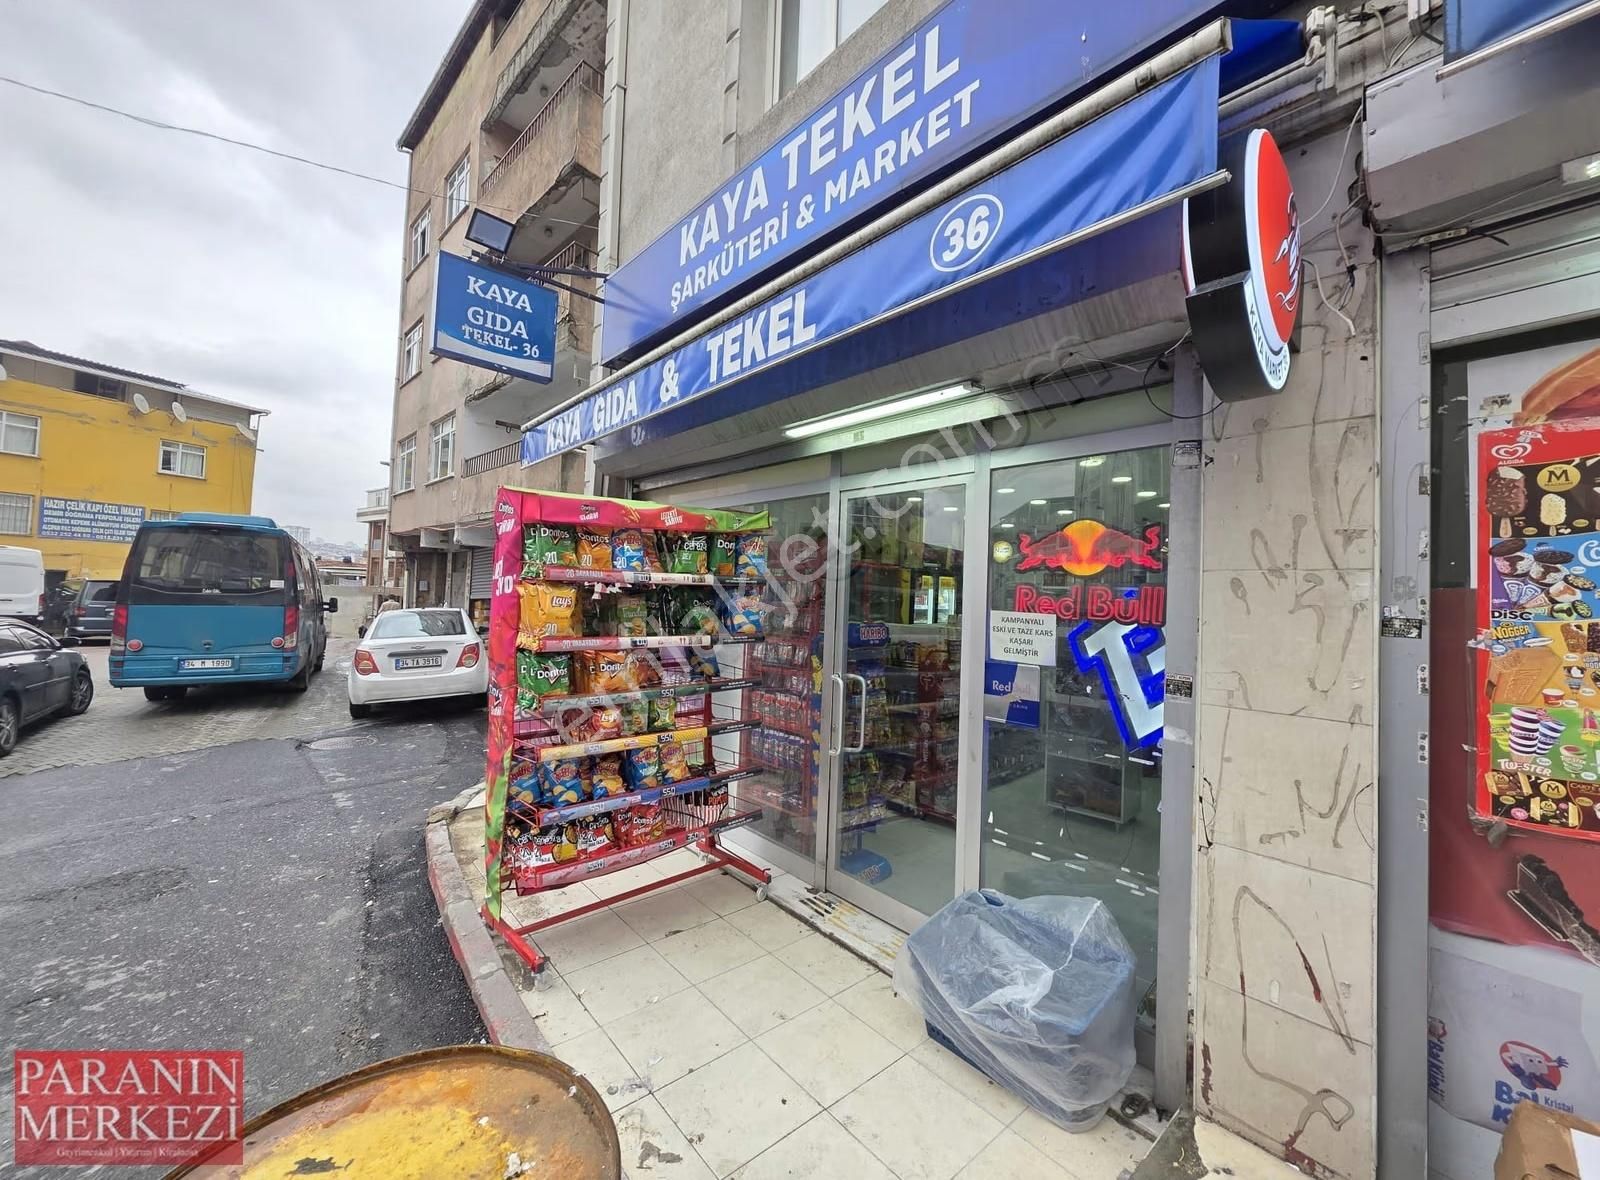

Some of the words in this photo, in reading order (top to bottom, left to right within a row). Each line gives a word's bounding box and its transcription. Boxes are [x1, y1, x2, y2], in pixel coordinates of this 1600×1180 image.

[679, 165, 769, 267] KAYA
[781, 25, 960, 190] TEKEL
[670, 201, 788, 313] ŞARKÜTERİ
[795, 193, 816, 230] &
[824, 79, 980, 214] MARKET
[942, 204, 990, 262] 36
[466, 275, 533, 313] KAYA
[467, 306, 529, 340] GIDA
[522, 343, 540, 358] 36
[546, 408, 581, 454] KAYA
[592, 380, 638, 433] GIDA
[659, 358, 680, 402] &
[706, 289, 817, 384] TEKEL
[43, 498, 65, 509] HAZIR
[87, 502, 103, 513] KAPI
[104, 502, 119, 514] ÖZEL
[541, 527, 570, 538] Doritos
[578, 532, 610, 543] Doritos
[551, 597, 573, 608] Lay's
[1015, 585, 1079, 620] Red
[1088, 585, 1165, 625] Bull
[1001, 616, 1044, 626] KAMPANYALI
[1017, 627, 1033, 635] TAZE
[1034, 629, 1053, 637] KARS
[1493, 625, 1531, 639] NOGGER
[1009, 637, 1033, 646] KAŞARI
[1003, 647, 1039, 657] GELMİŞTİR
[537, 668, 568, 679] Doritos
[993, 680, 1011, 692] Red
[1543, 1096, 1574, 1114] Kristal
